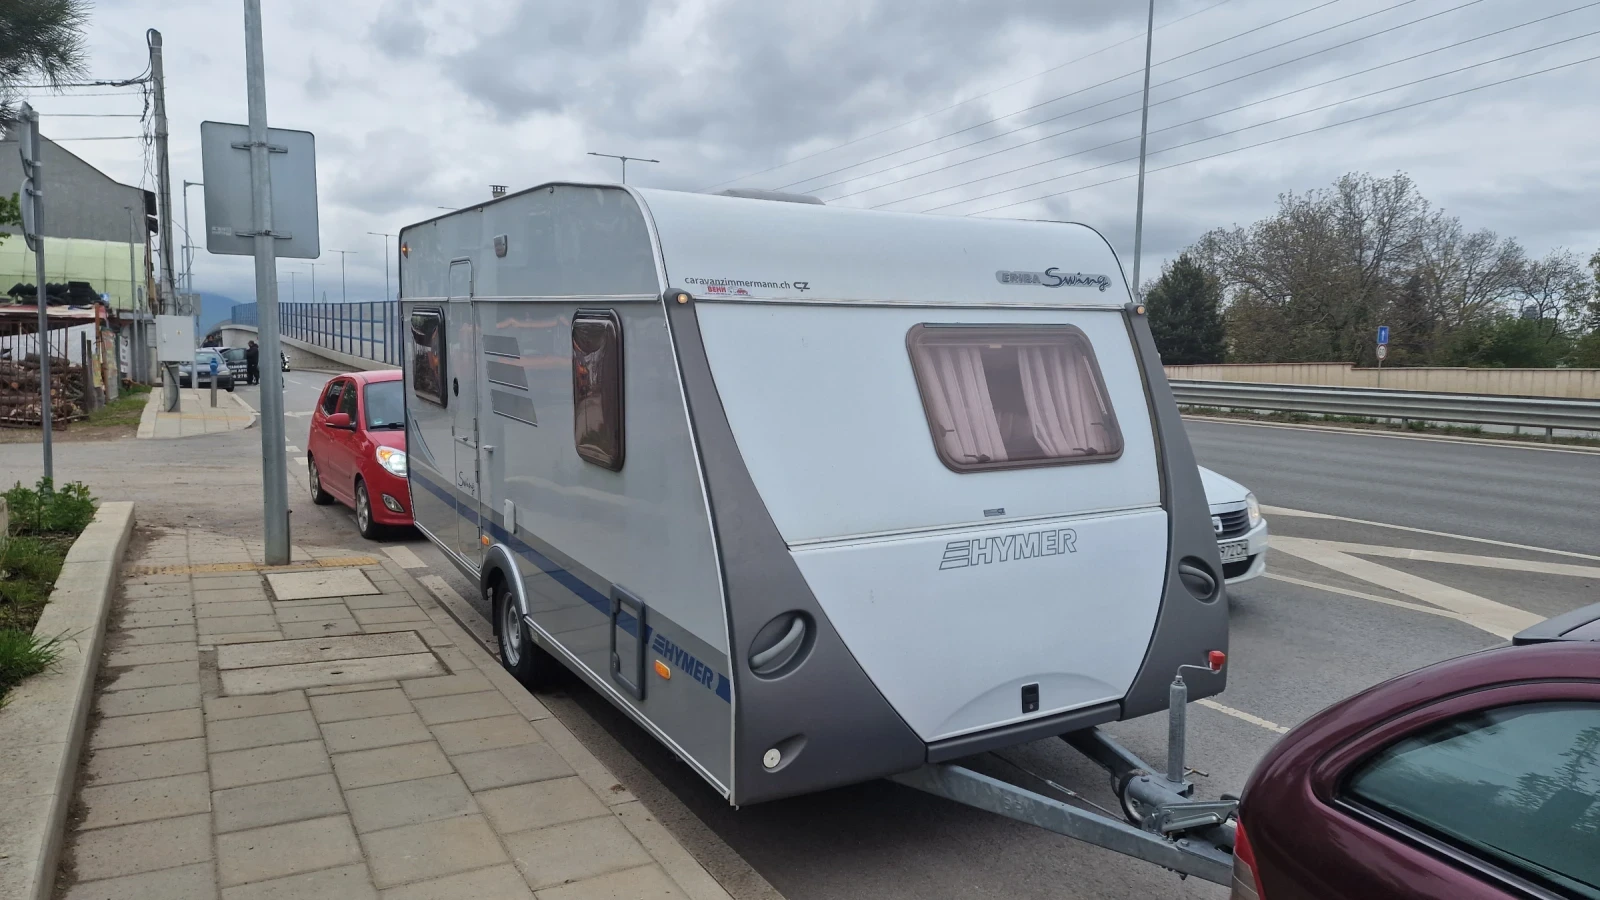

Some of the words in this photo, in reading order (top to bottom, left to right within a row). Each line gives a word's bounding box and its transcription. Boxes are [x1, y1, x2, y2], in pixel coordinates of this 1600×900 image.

[684, 277, 791, 290] caravanzimmermann.ch
[1001, 272, 1041, 284] ERIBA
[1042, 267, 1110, 292] Swing
[970, 528, 1077, 566] HYMER
[663, 639, 714, 690] HYMER
